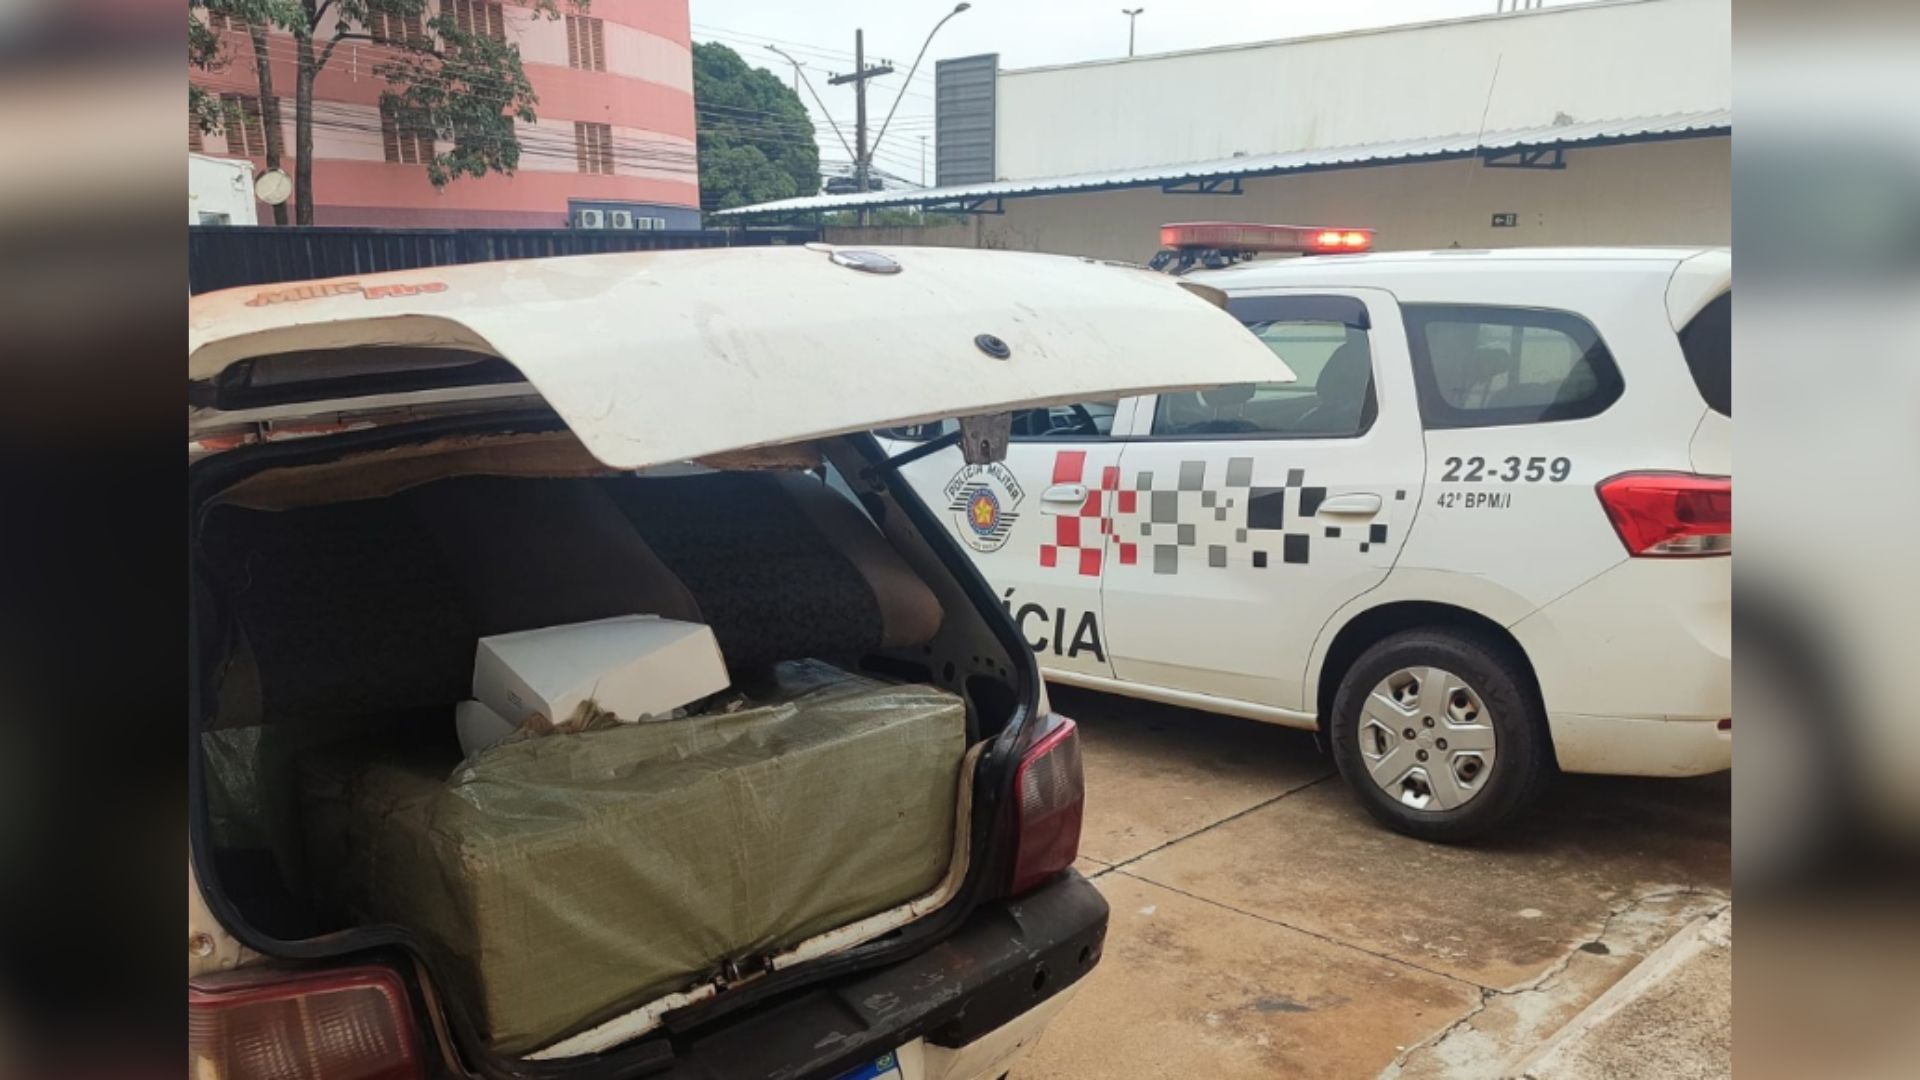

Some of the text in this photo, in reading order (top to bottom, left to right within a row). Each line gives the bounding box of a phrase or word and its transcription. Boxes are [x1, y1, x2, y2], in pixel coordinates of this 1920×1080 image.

[1441, 456, 1572, 482] 22-359
[986, 464, 1020, 501] MILITAR
[1464, 492, 1511, 508] BPM/I
